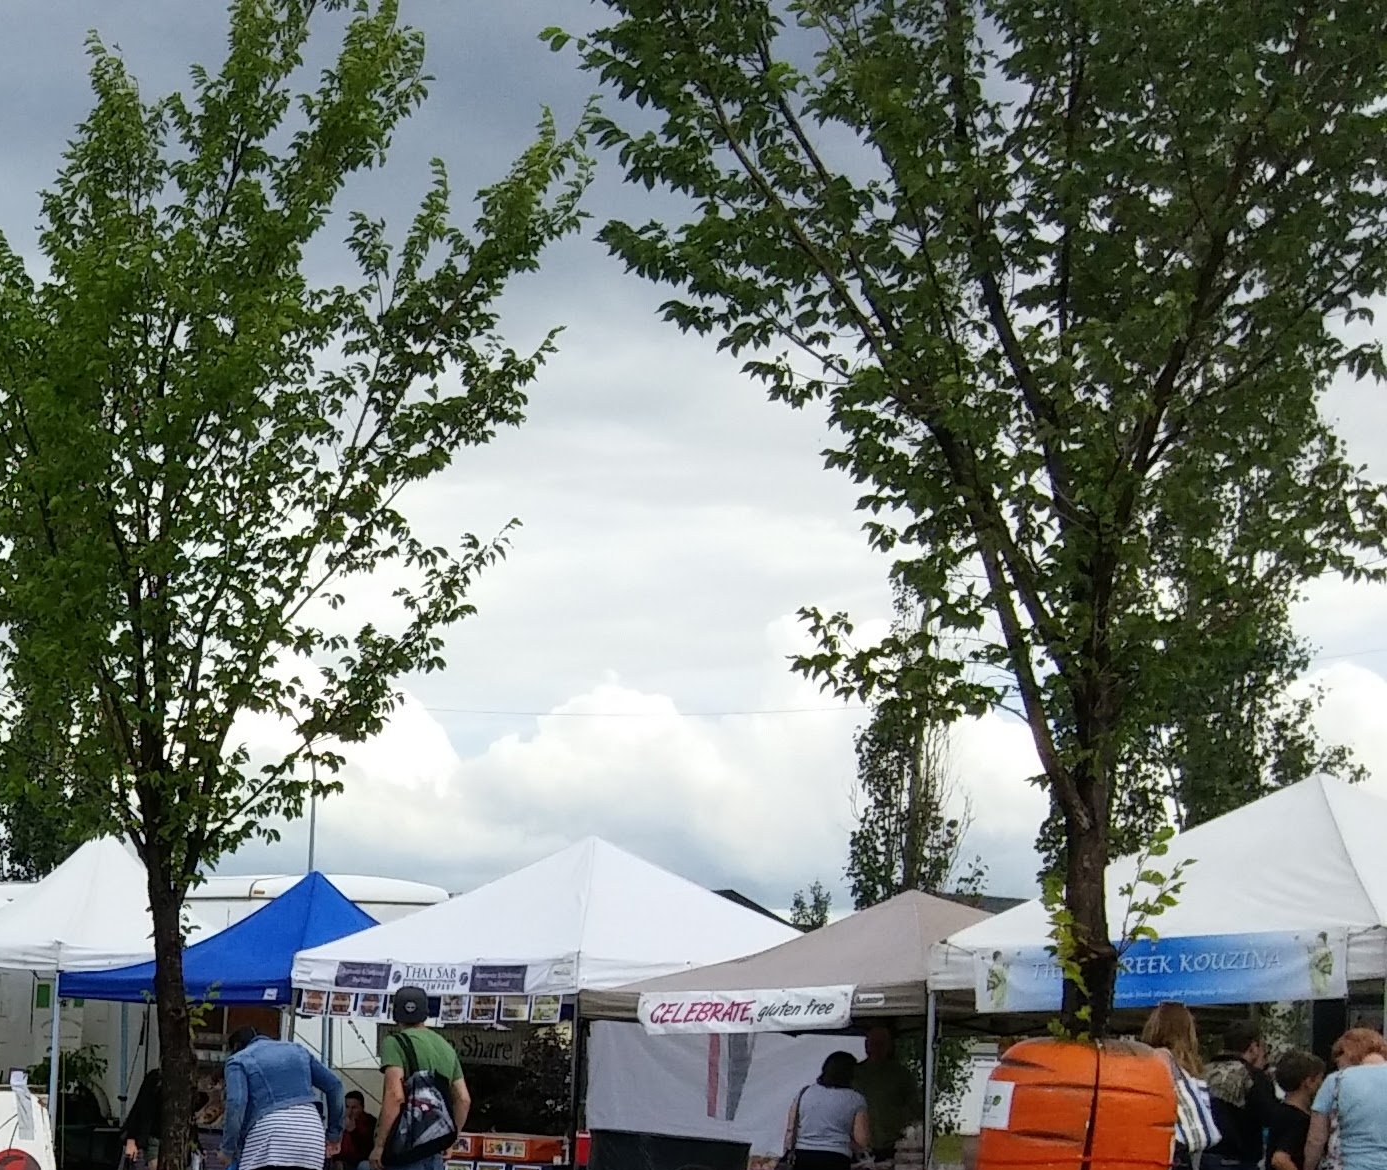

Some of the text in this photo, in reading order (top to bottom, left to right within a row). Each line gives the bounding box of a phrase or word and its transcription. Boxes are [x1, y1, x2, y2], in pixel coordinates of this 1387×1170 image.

[405, 965, 457, 979] THAI SAB
[1116, 955, 1173, 977] REEK
[1179, 949, 1283, 974] KOUZINA
[650, 998, 834, 1025] CELEBRATE, gluten free
[461, 1034, 513, 1060] Share
